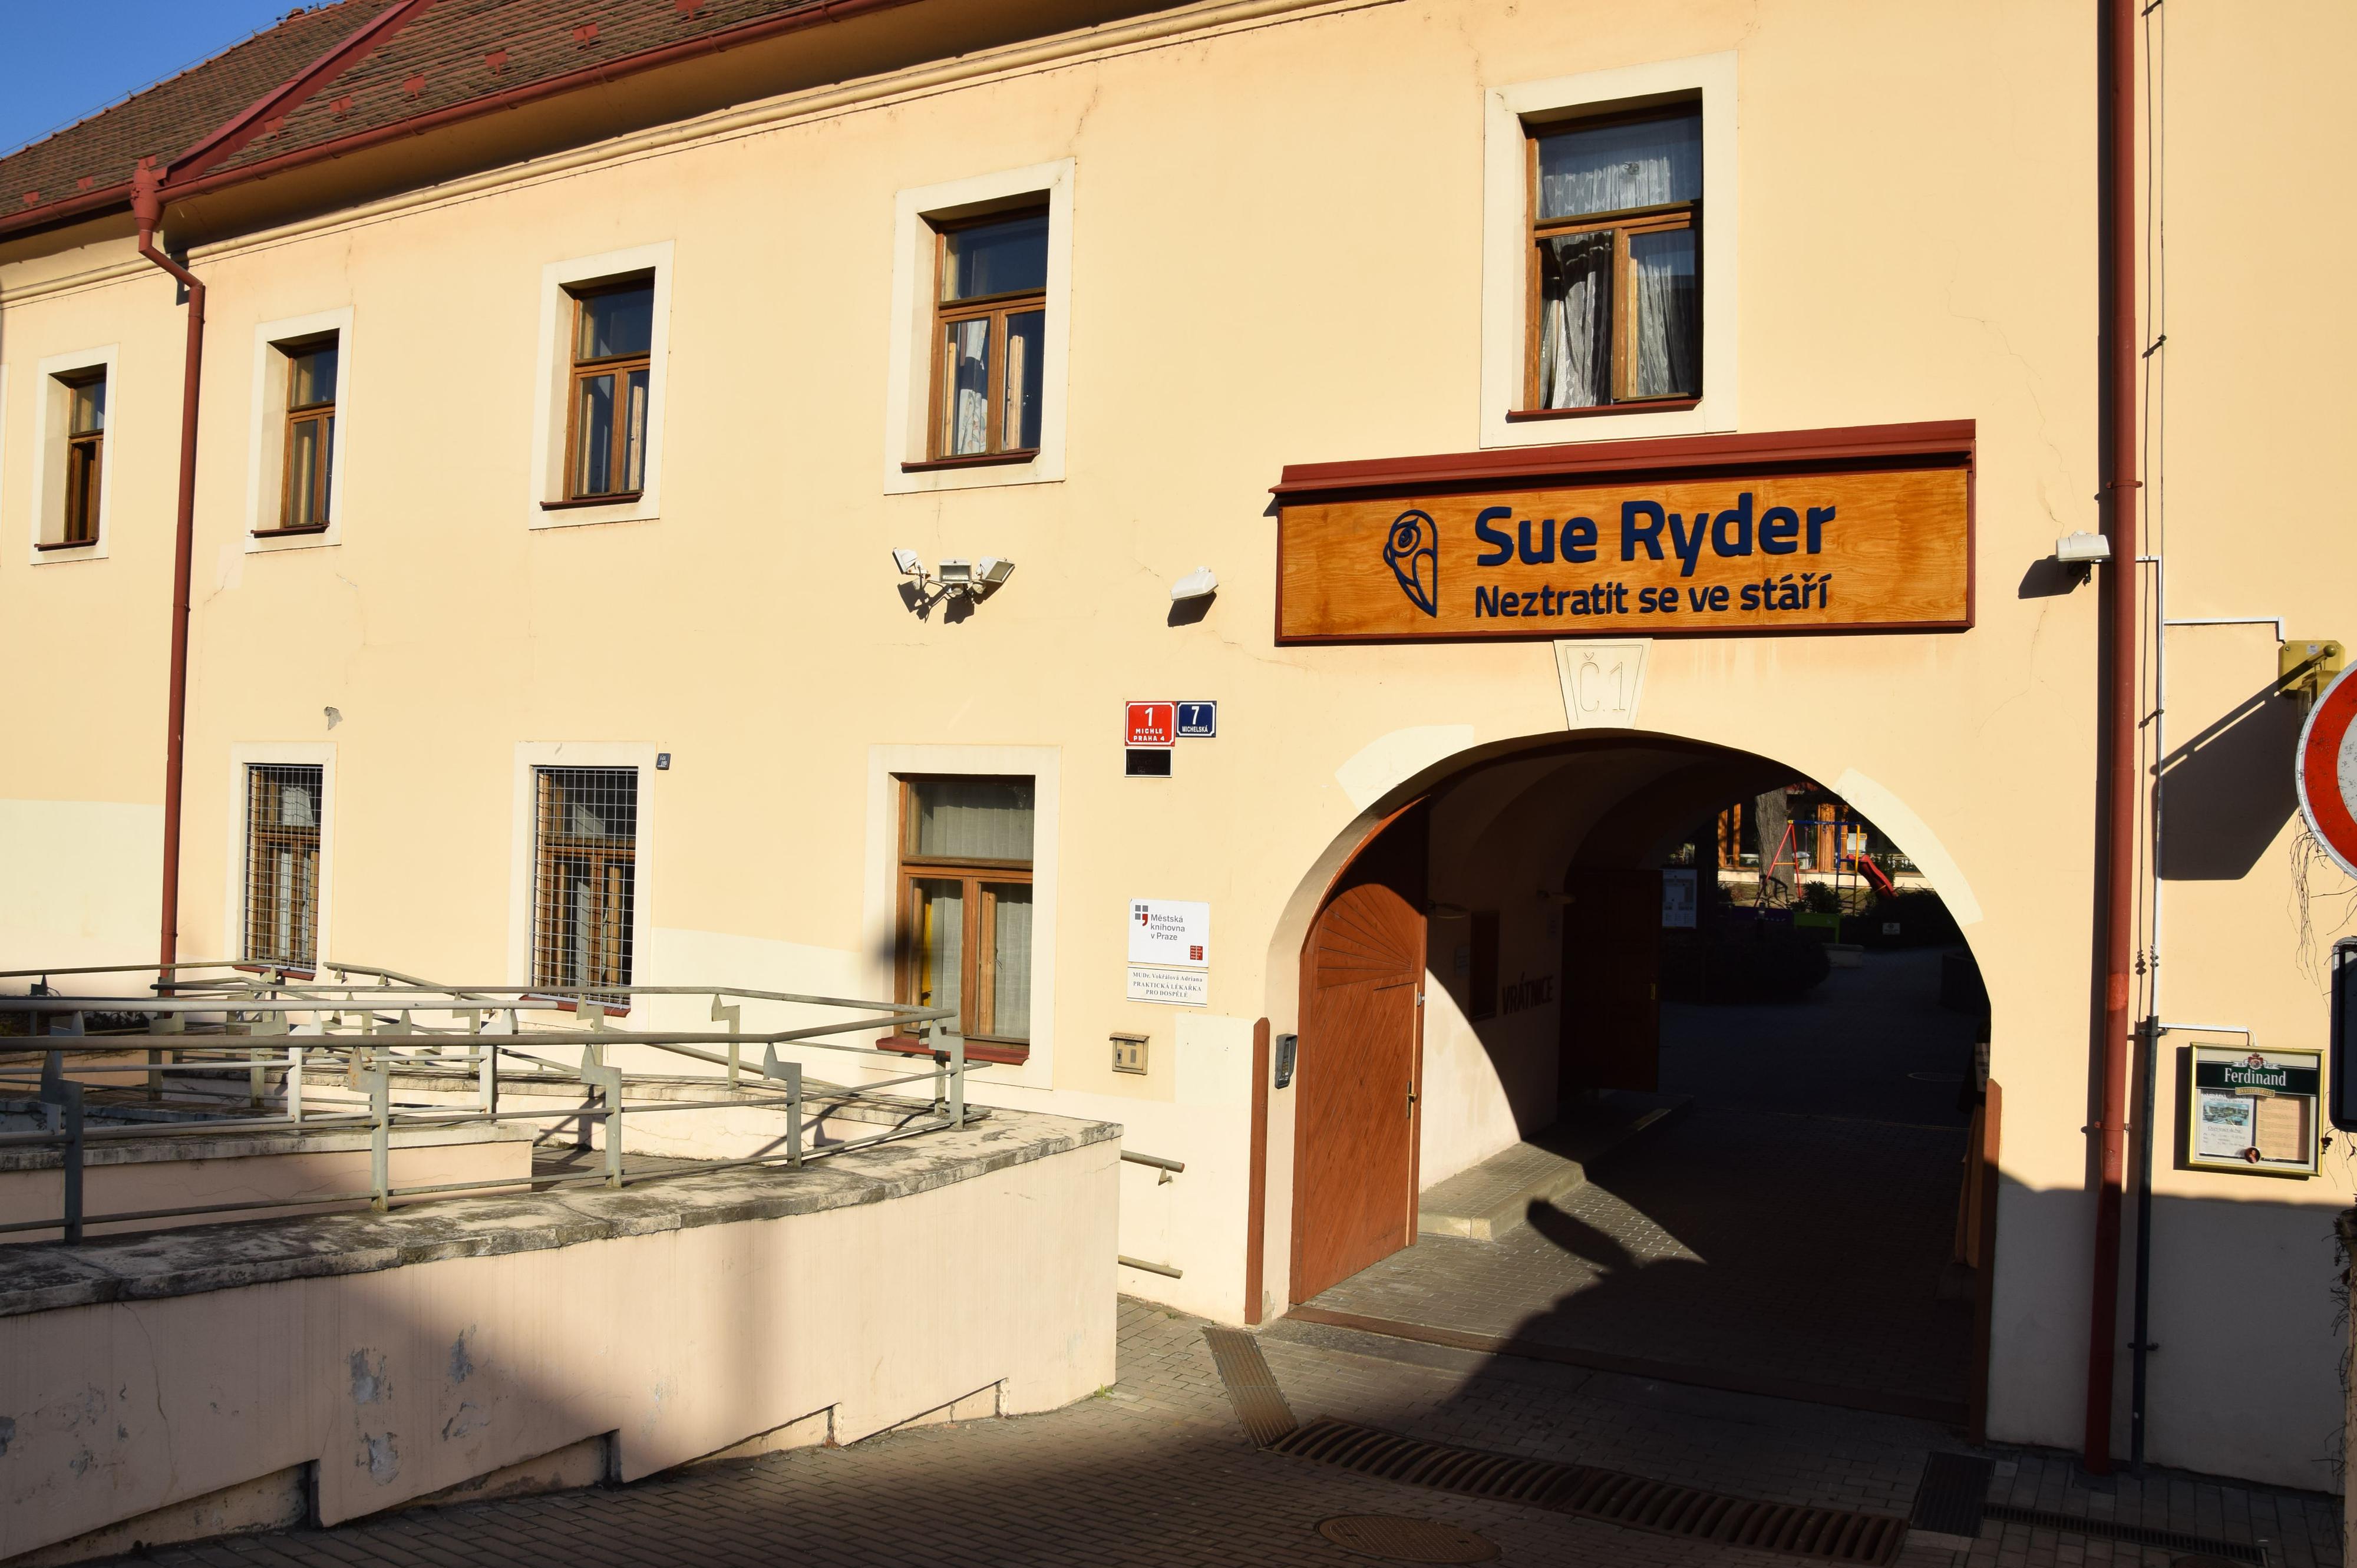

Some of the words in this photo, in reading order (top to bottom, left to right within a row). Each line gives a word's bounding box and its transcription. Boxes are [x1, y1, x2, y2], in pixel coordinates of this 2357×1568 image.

[1475, 506, 1598, 567] Sue
[1620, 492, 1836, 577] Ryder
[1475, 581, 1629, 618] Neztratit
[1639, 585, 1679, 613] se
[1688, 585, 1730, 612] ve
[1740, 572, 1833, 611] stáří
[1144, 707, 1153, 727] 1
[1191, 705, 1200, 725] 7
[1150, 914, 1184, 923] Městská
[1150, 923, 1186, 932] knihovna
[1156, 932, 1178, 940] Praze
[1502, 972, 1554, 1015] VRÁTNICE
[2224, 1067, 2287, 1087] Ferdinand
